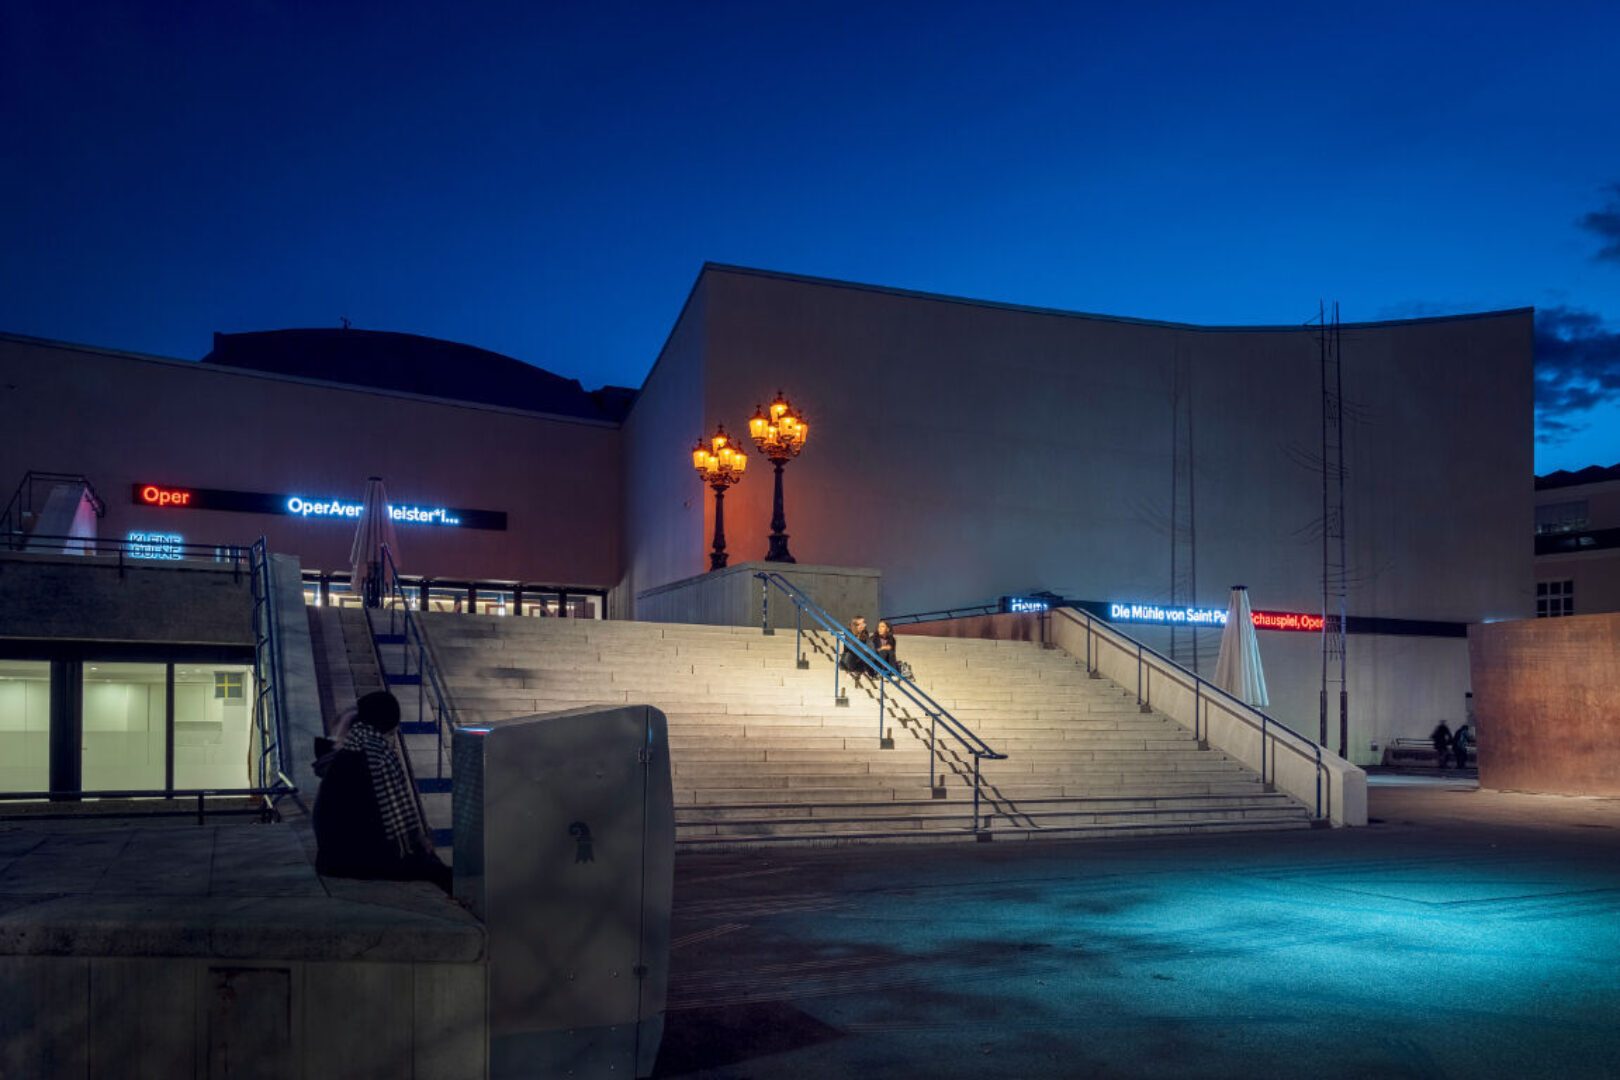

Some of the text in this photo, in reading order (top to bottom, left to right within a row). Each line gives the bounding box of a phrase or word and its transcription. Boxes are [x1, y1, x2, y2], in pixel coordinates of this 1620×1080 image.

[143, 486, 190, 506] Oper
[1111, 604, 1130, 618] Die
[1131, 605, 1165, 620] Mühle
[1165, 609, 1185, 621] von
[1186, 608, 1213, 623] Saint
[1301, 615, 1324, 630] Oper
